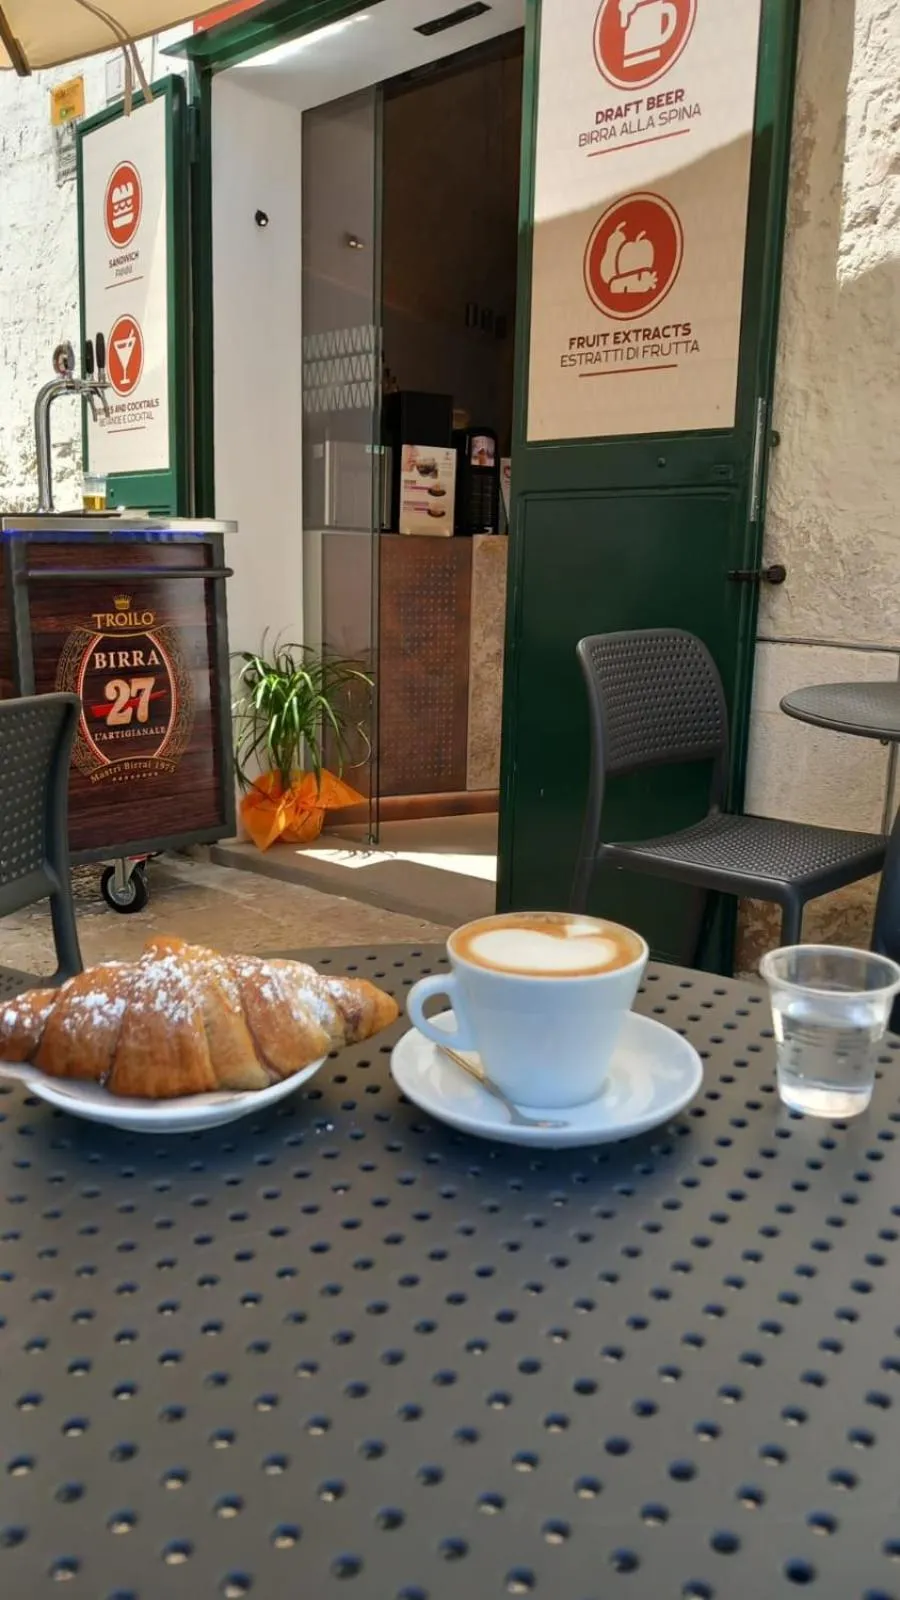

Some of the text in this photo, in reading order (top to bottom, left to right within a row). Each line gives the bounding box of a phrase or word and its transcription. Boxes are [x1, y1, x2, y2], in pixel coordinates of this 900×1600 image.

[595, 88, 685, 125] DRAFT BEER
[578, 103, 702, 147] BIRRA ALLA SPINA
[568, 322, 692, 350] FRUIT EXTRACTS
[560, 339, 700, 368] ESTRATTI DI FRUTTA
[127, 398, 160, 411] COCKTAILS
[127, 410, 154, 423] COCKTAIL
[92, 611, 154, 629] TROILO
[93, 649, 161, 669] BIRRA
[105, 677, 155, 725] 27
[95, 726, 166, 741] L'ARTIGIANALE
